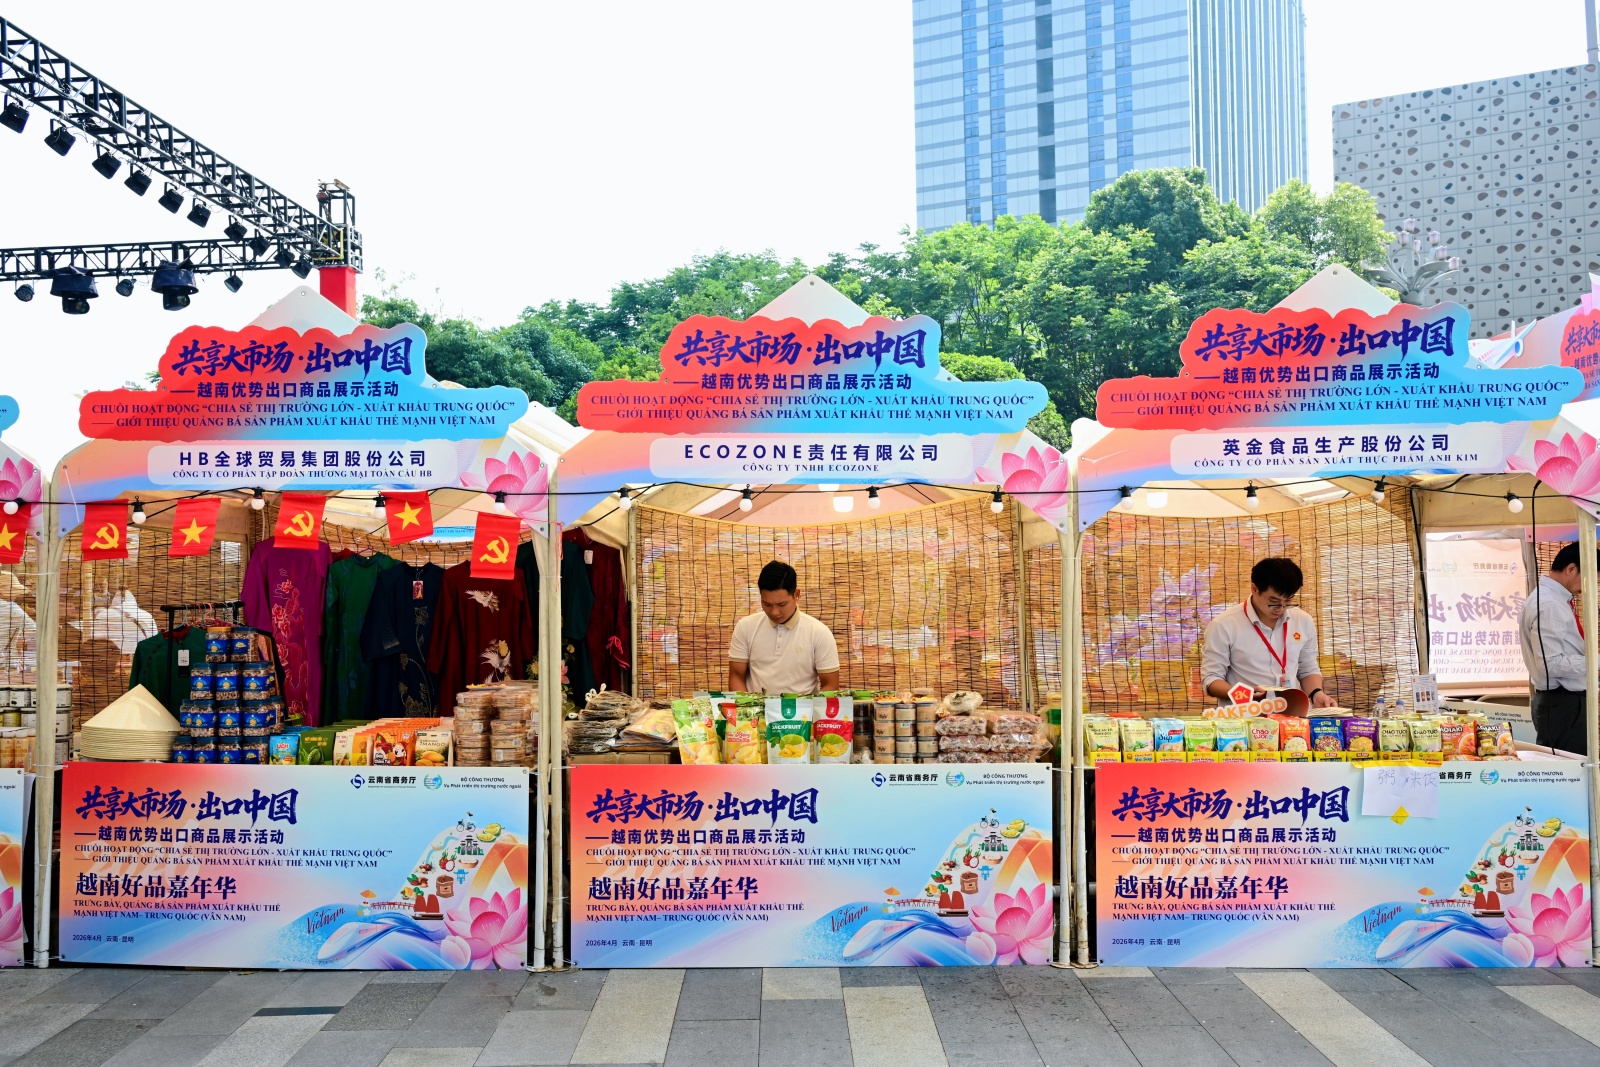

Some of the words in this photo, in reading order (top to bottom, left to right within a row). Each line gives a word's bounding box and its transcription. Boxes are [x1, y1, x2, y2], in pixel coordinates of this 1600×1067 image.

[1194, 316, 1456, 362] 共享大市场·出口中国
[172, 338, 412, 380] 共享大市场·出口中国
[674, 329, 926, 371] 共享大市场·出口中国
[634, 393, 666, 406] HOẠT
[670, 393, 704, 406] ĐỘNG
[707, 393, 742, 404] “CHIA
[763, 393, 782, 408] THỊ
[786, 393, 836, 404] TRƯỜNG
[841, 393, 864, 404] LỚN
[948, 396, 990, 404] TRUNG
[1154, 391, 1188, 402] HOẠT
[1191, 390, 1226, 401] ĐỘNG
[1229, 387, 1266, 403] “CHIA
[1286, 386, 1306, 402] THỊ
[1310, 386, 1362, 401] TRƯỜNG
[1366, 384, 1390, 395] LỚN
[1478, 382, 1522, 392] TRUNG
[132, 404, 164, 415] HOẠT
[167, 404, 200, 414] ĐỘNG
[202, 400, 236, 415] “CHIA
[256, 400, 276, 414] THỊ
[279, 403, 328, 412] TRƯỜNG
[332, 400, 354, 412] LỚN
[434, 402, 474, 411] TRUNG
[617, 408, 642, 422] GIỚI
[646, 408, 682, 420] THIỆU
[732, 408, 748, 418] BÁ
[916, 410, 950, 420] MẠNH
[955, 409, 982, 420] VIỆT
[986, 410, 1012, 418] NAM
[1137, 404, 1164, 418] GIỚI
[1167, 405, 1204, 417] THIỆU
[1255, 400, 1270, 412] BÁ
[1444, 398, 1480, 409] MẠNH
[1485, 397, 1514, 408] VIỆT
[1518, 396, 1546, 405] NAM
[116, 415, 142, 426] GIỚI
[145, 415, 180, 428] THIỆU
[227, 415, 242, 426] BÁ
[402, 416, 436, 427] MẠNH
[440, 415, 466, 427] VIỆT
[470, 415, 496, 424] NAM
[685, 444, 938, 461] ECOZONE责任有限公司
[1223, 434, 1448, 455] 英金食品生产股份公司
[180, 450, 425, 467] HB全球贸易集团股份公司
[743, 462, 772, 471] CÔNG
[1194, 458, 1224, 467] CÔNG
[1358, 455, 1388, 464] THỰC
[1457, 453, 1478, 461] KIM
[173, 469, 199, 477] CÔNG
[260, 470, 277, 479] TẬP
[350, 470, 367, 478] MẠI
[368, 776, 416, 784] 云南省商务厅
[888, 774, 938, 782] 云南省商务厅
[76, 785, 298, 828] 共享大市场·出口中国
[586, 788, 818, 829] 共享大市场·出口中国
[1112, 786, 1350, 827] 共享大市场·出口中国
[76, 872, 236, 899] 越南好品嘉年华
[589, 876, 758, 900] 越南好品嘉年华
[1115, 875, 1288, 899] 越南好品嘉年华
[306, 908, 346, 935] Vietnam
[831, 905, 870, 933] Vietnam
[1363, 905, 1402, 934] Vietnam
